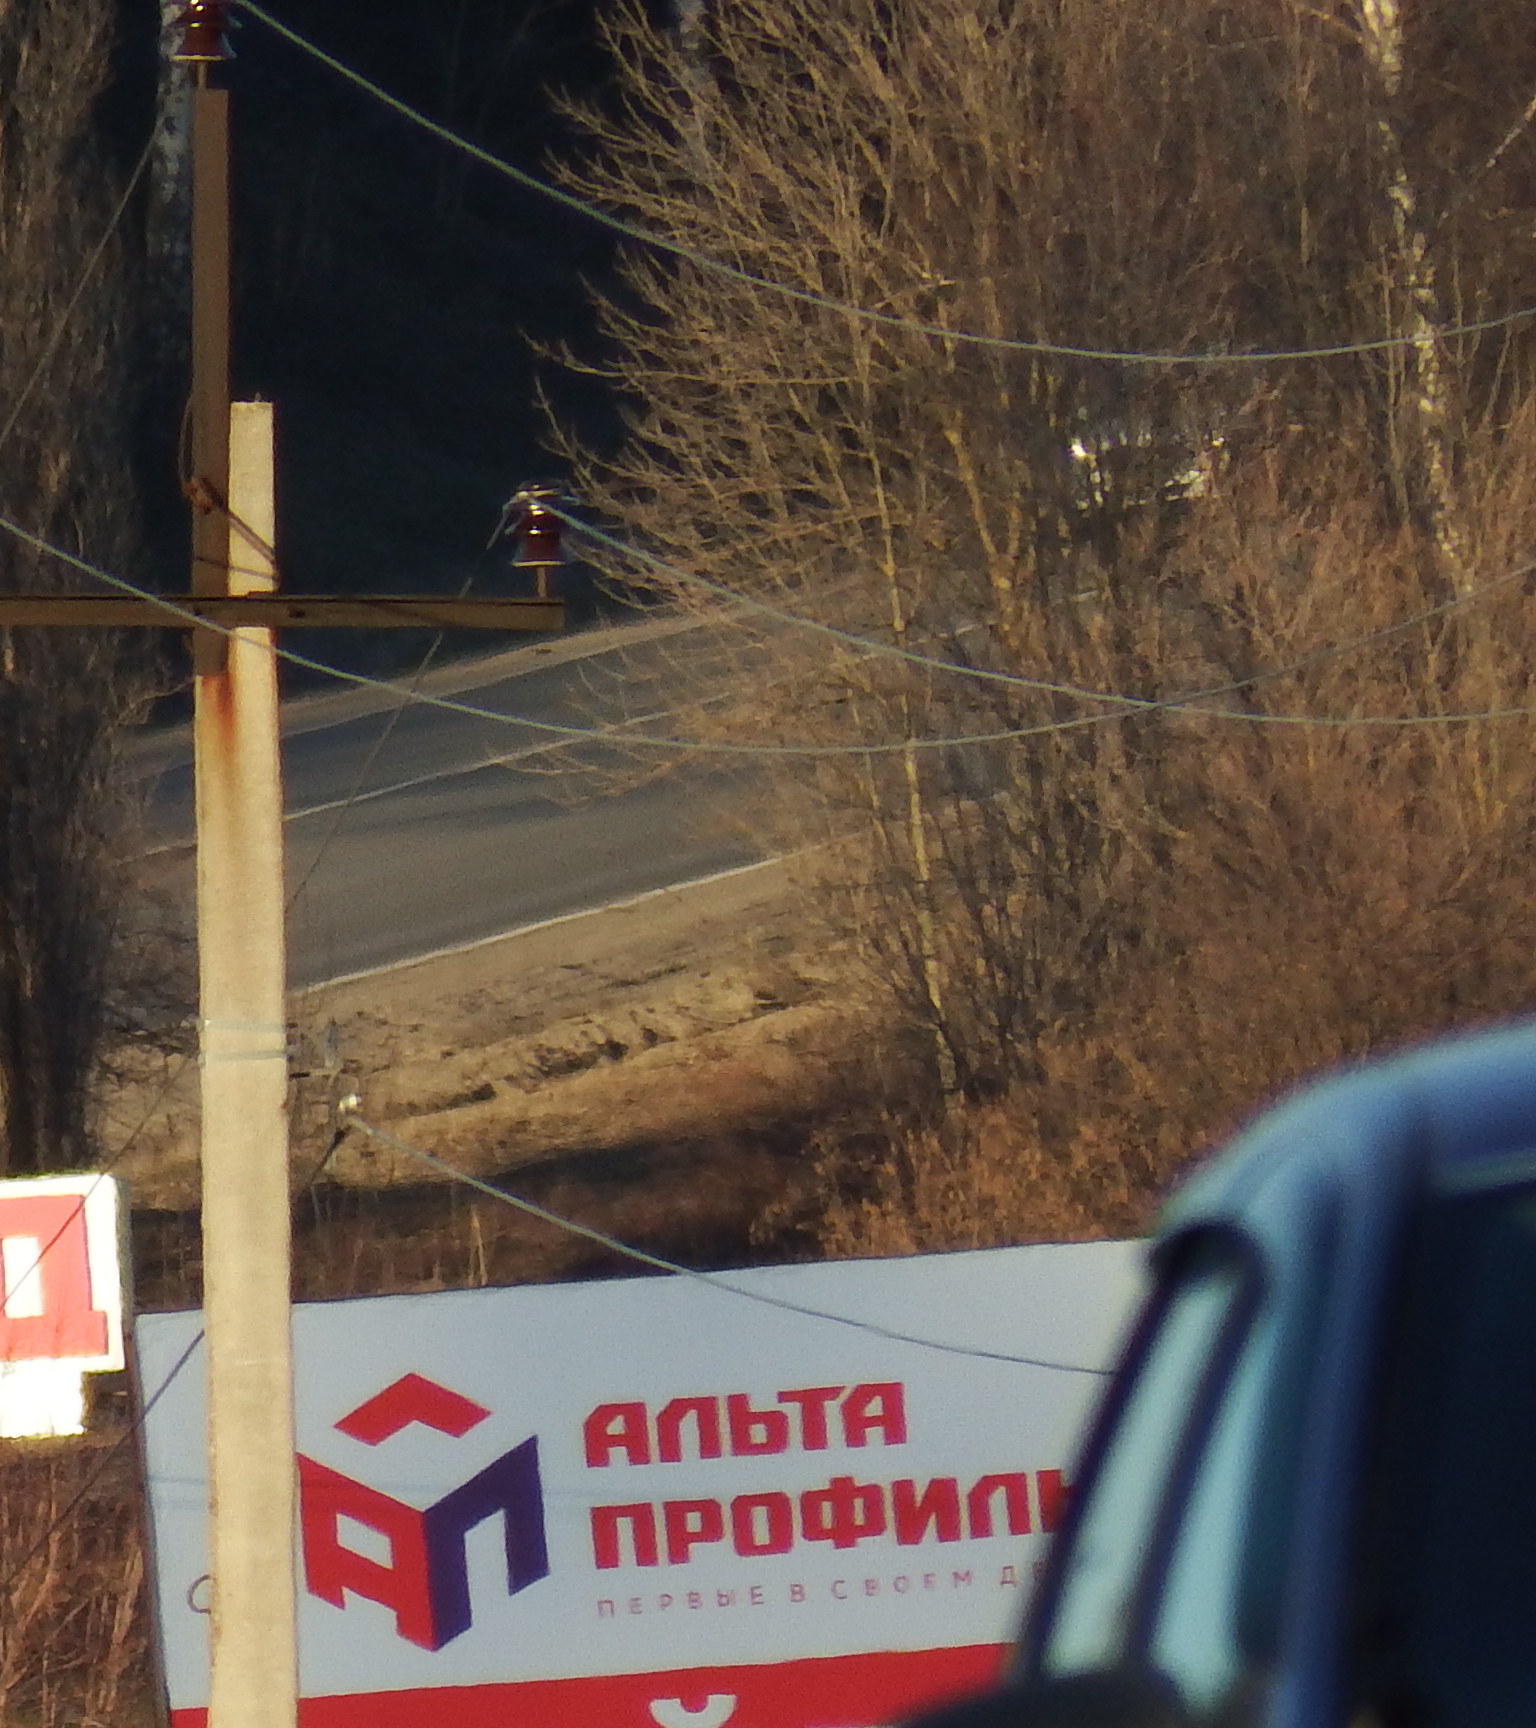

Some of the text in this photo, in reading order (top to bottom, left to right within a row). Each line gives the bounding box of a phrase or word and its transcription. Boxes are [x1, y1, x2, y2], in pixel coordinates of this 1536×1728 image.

[582, 1381, 907, 1468] АЛЬТА
[596, 1584, 765, 1619] ПЕРВЫЕ
[830, 1568, 973, 1600] СВОЕМ
